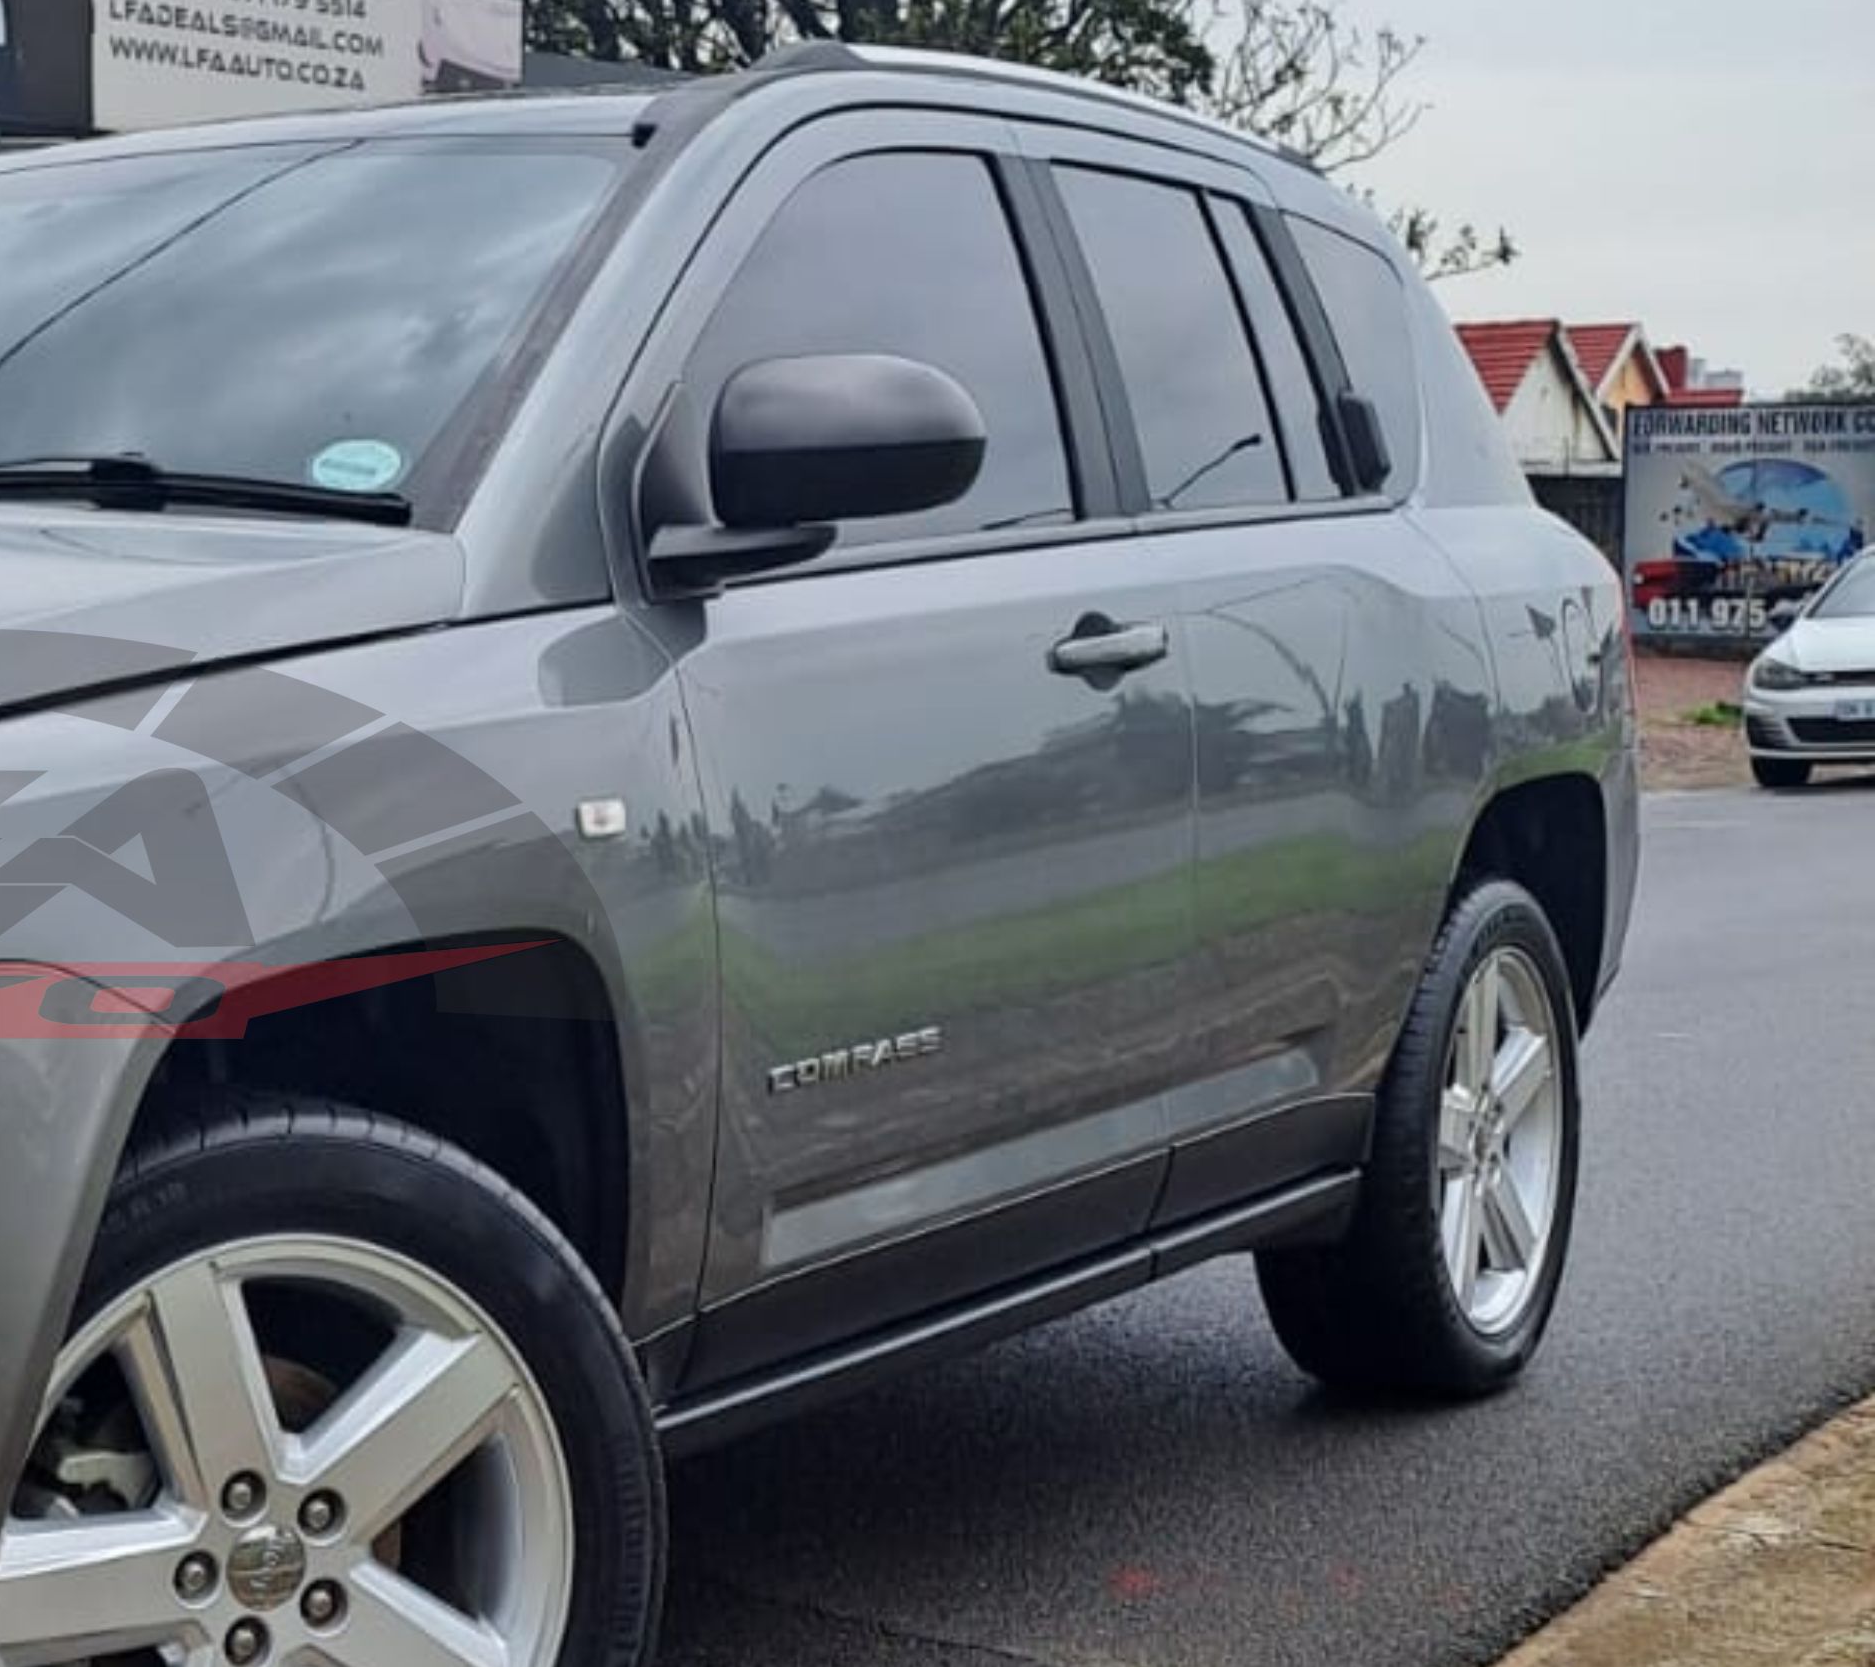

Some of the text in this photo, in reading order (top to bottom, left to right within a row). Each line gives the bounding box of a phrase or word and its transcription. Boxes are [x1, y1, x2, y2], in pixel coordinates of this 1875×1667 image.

[1633, 410, 1751, 435] FORWARDING
[1757, 410, 1846, 435] NETWORK
[1648, 597, 1767, 628] 011 975
[768, 1026, 941, 1092] COMPASS
